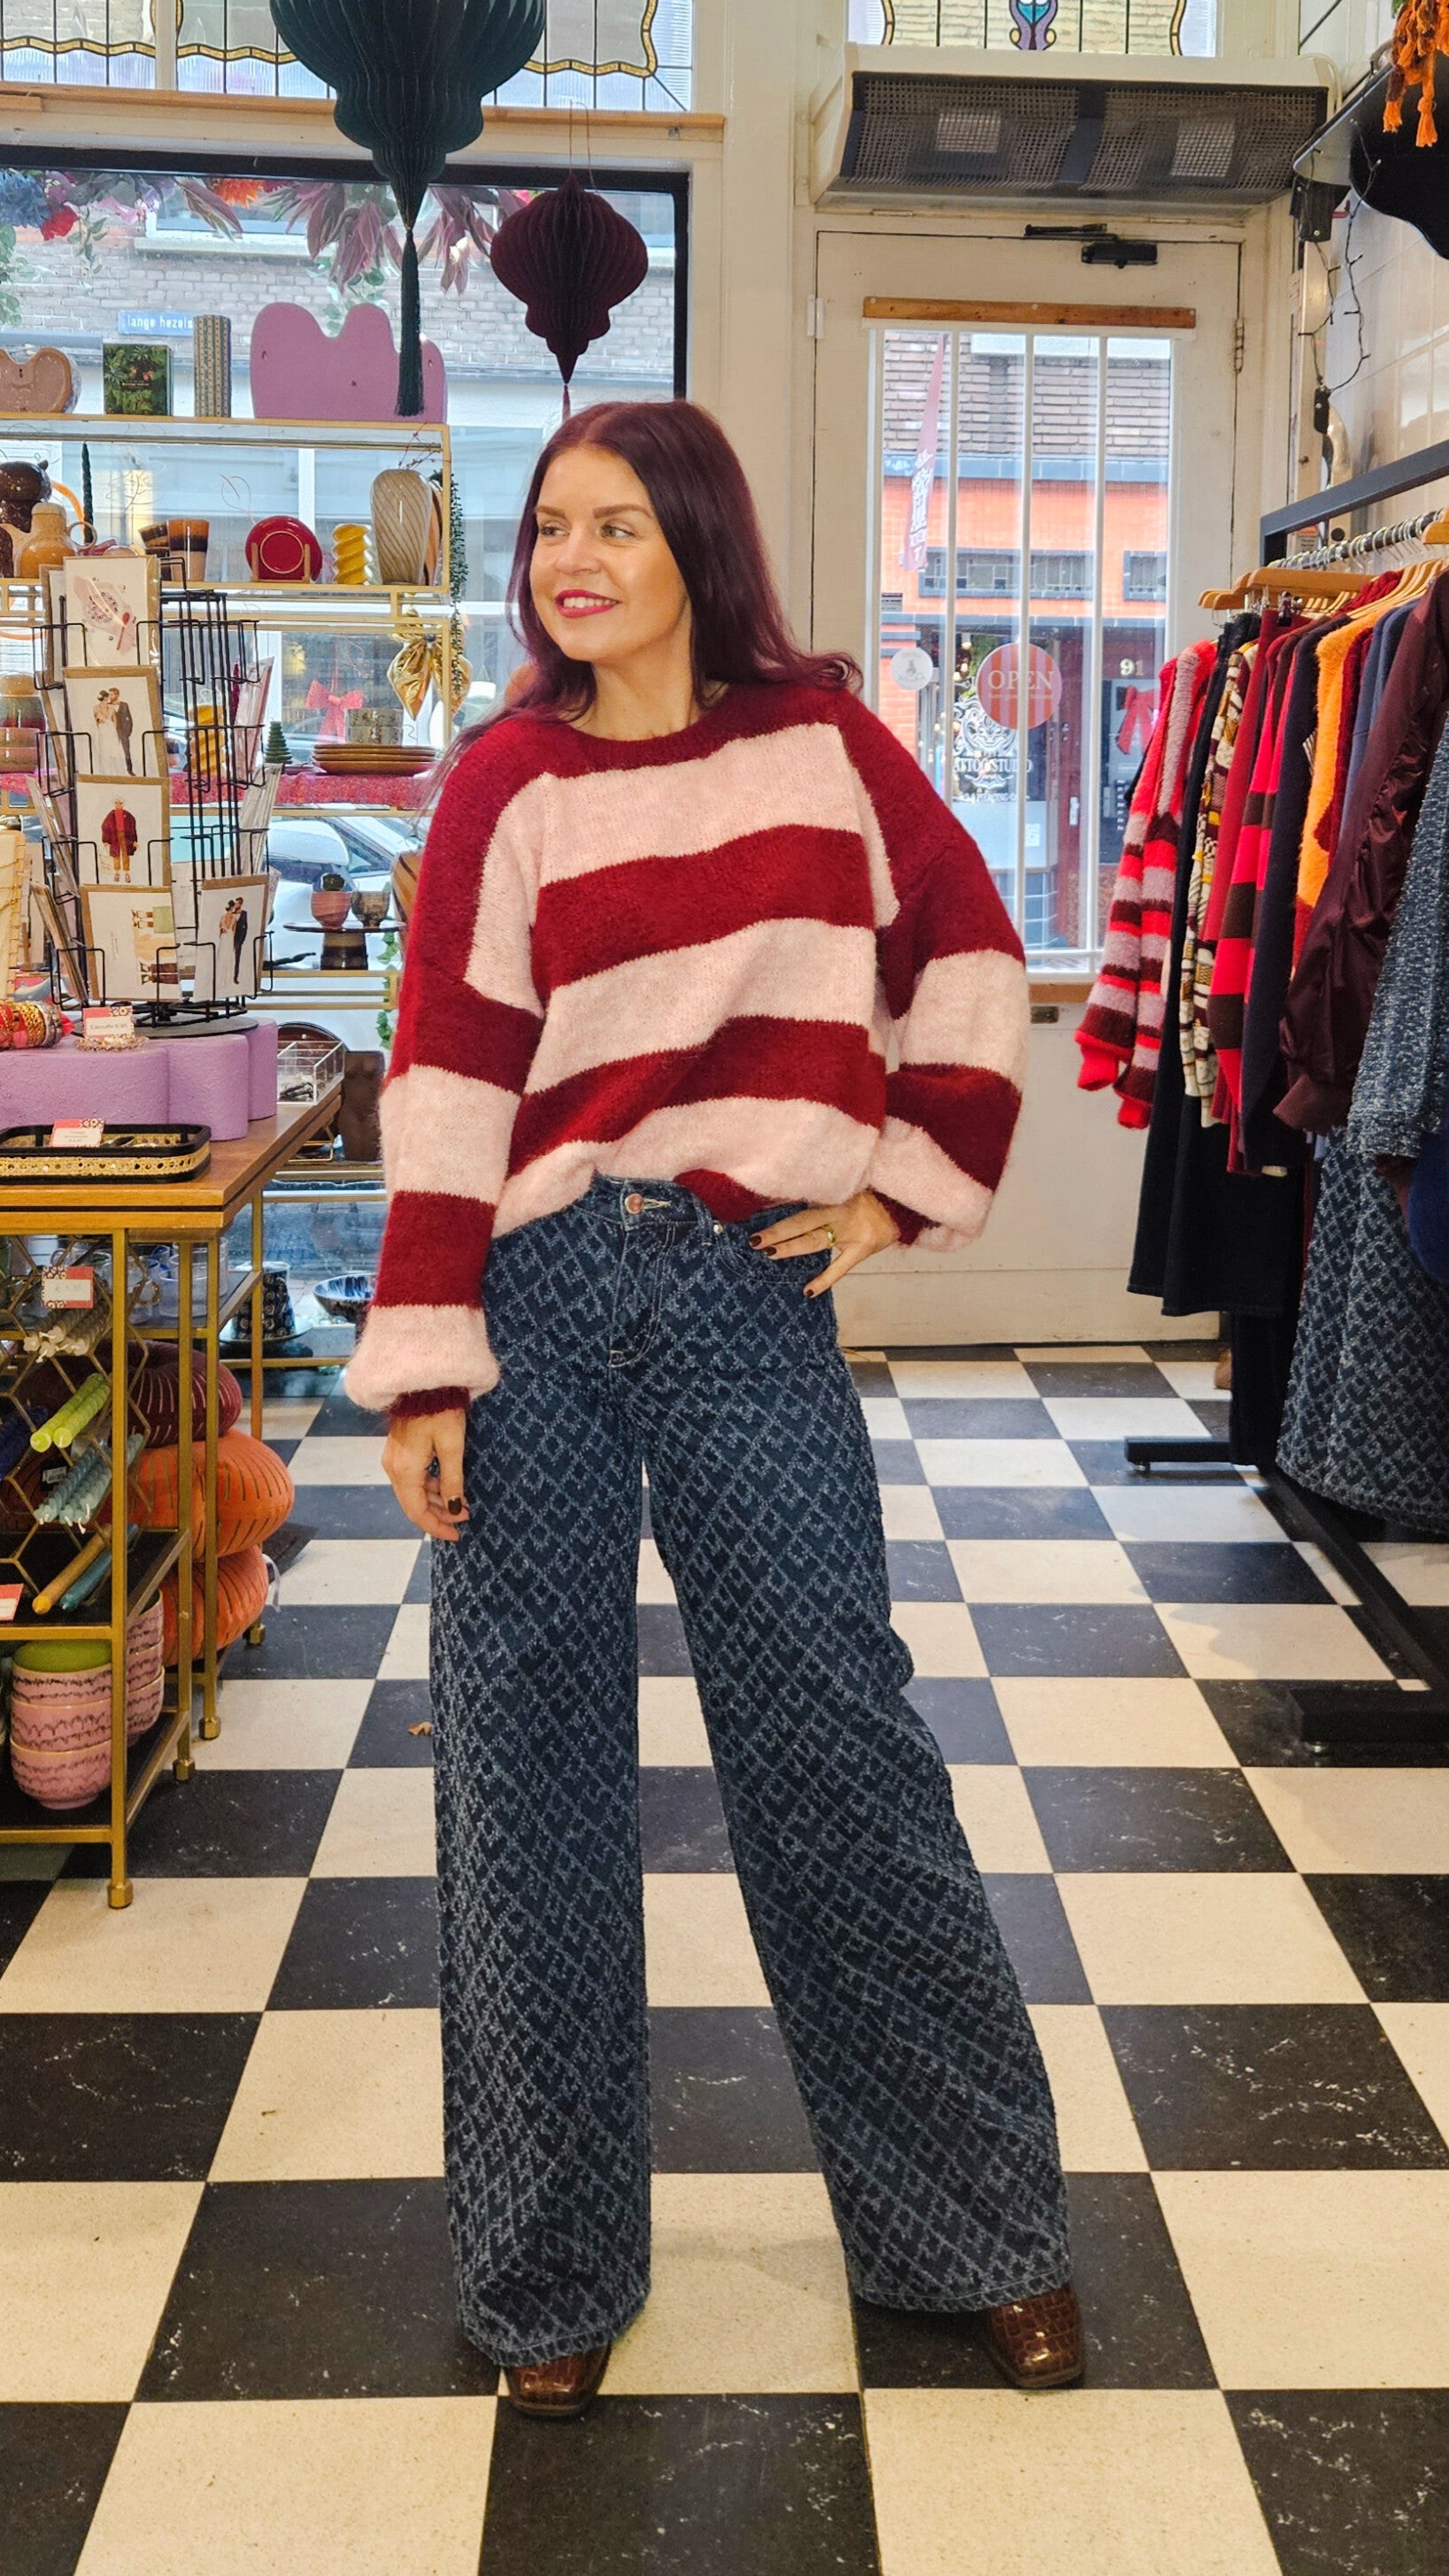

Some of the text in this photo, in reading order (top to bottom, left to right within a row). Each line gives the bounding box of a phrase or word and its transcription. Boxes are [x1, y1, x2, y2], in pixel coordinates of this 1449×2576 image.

[127, 314, 155, 331] lange
[1120, 658, 1145, 676] 91
[988, 670, 1054, 690] OPEN
